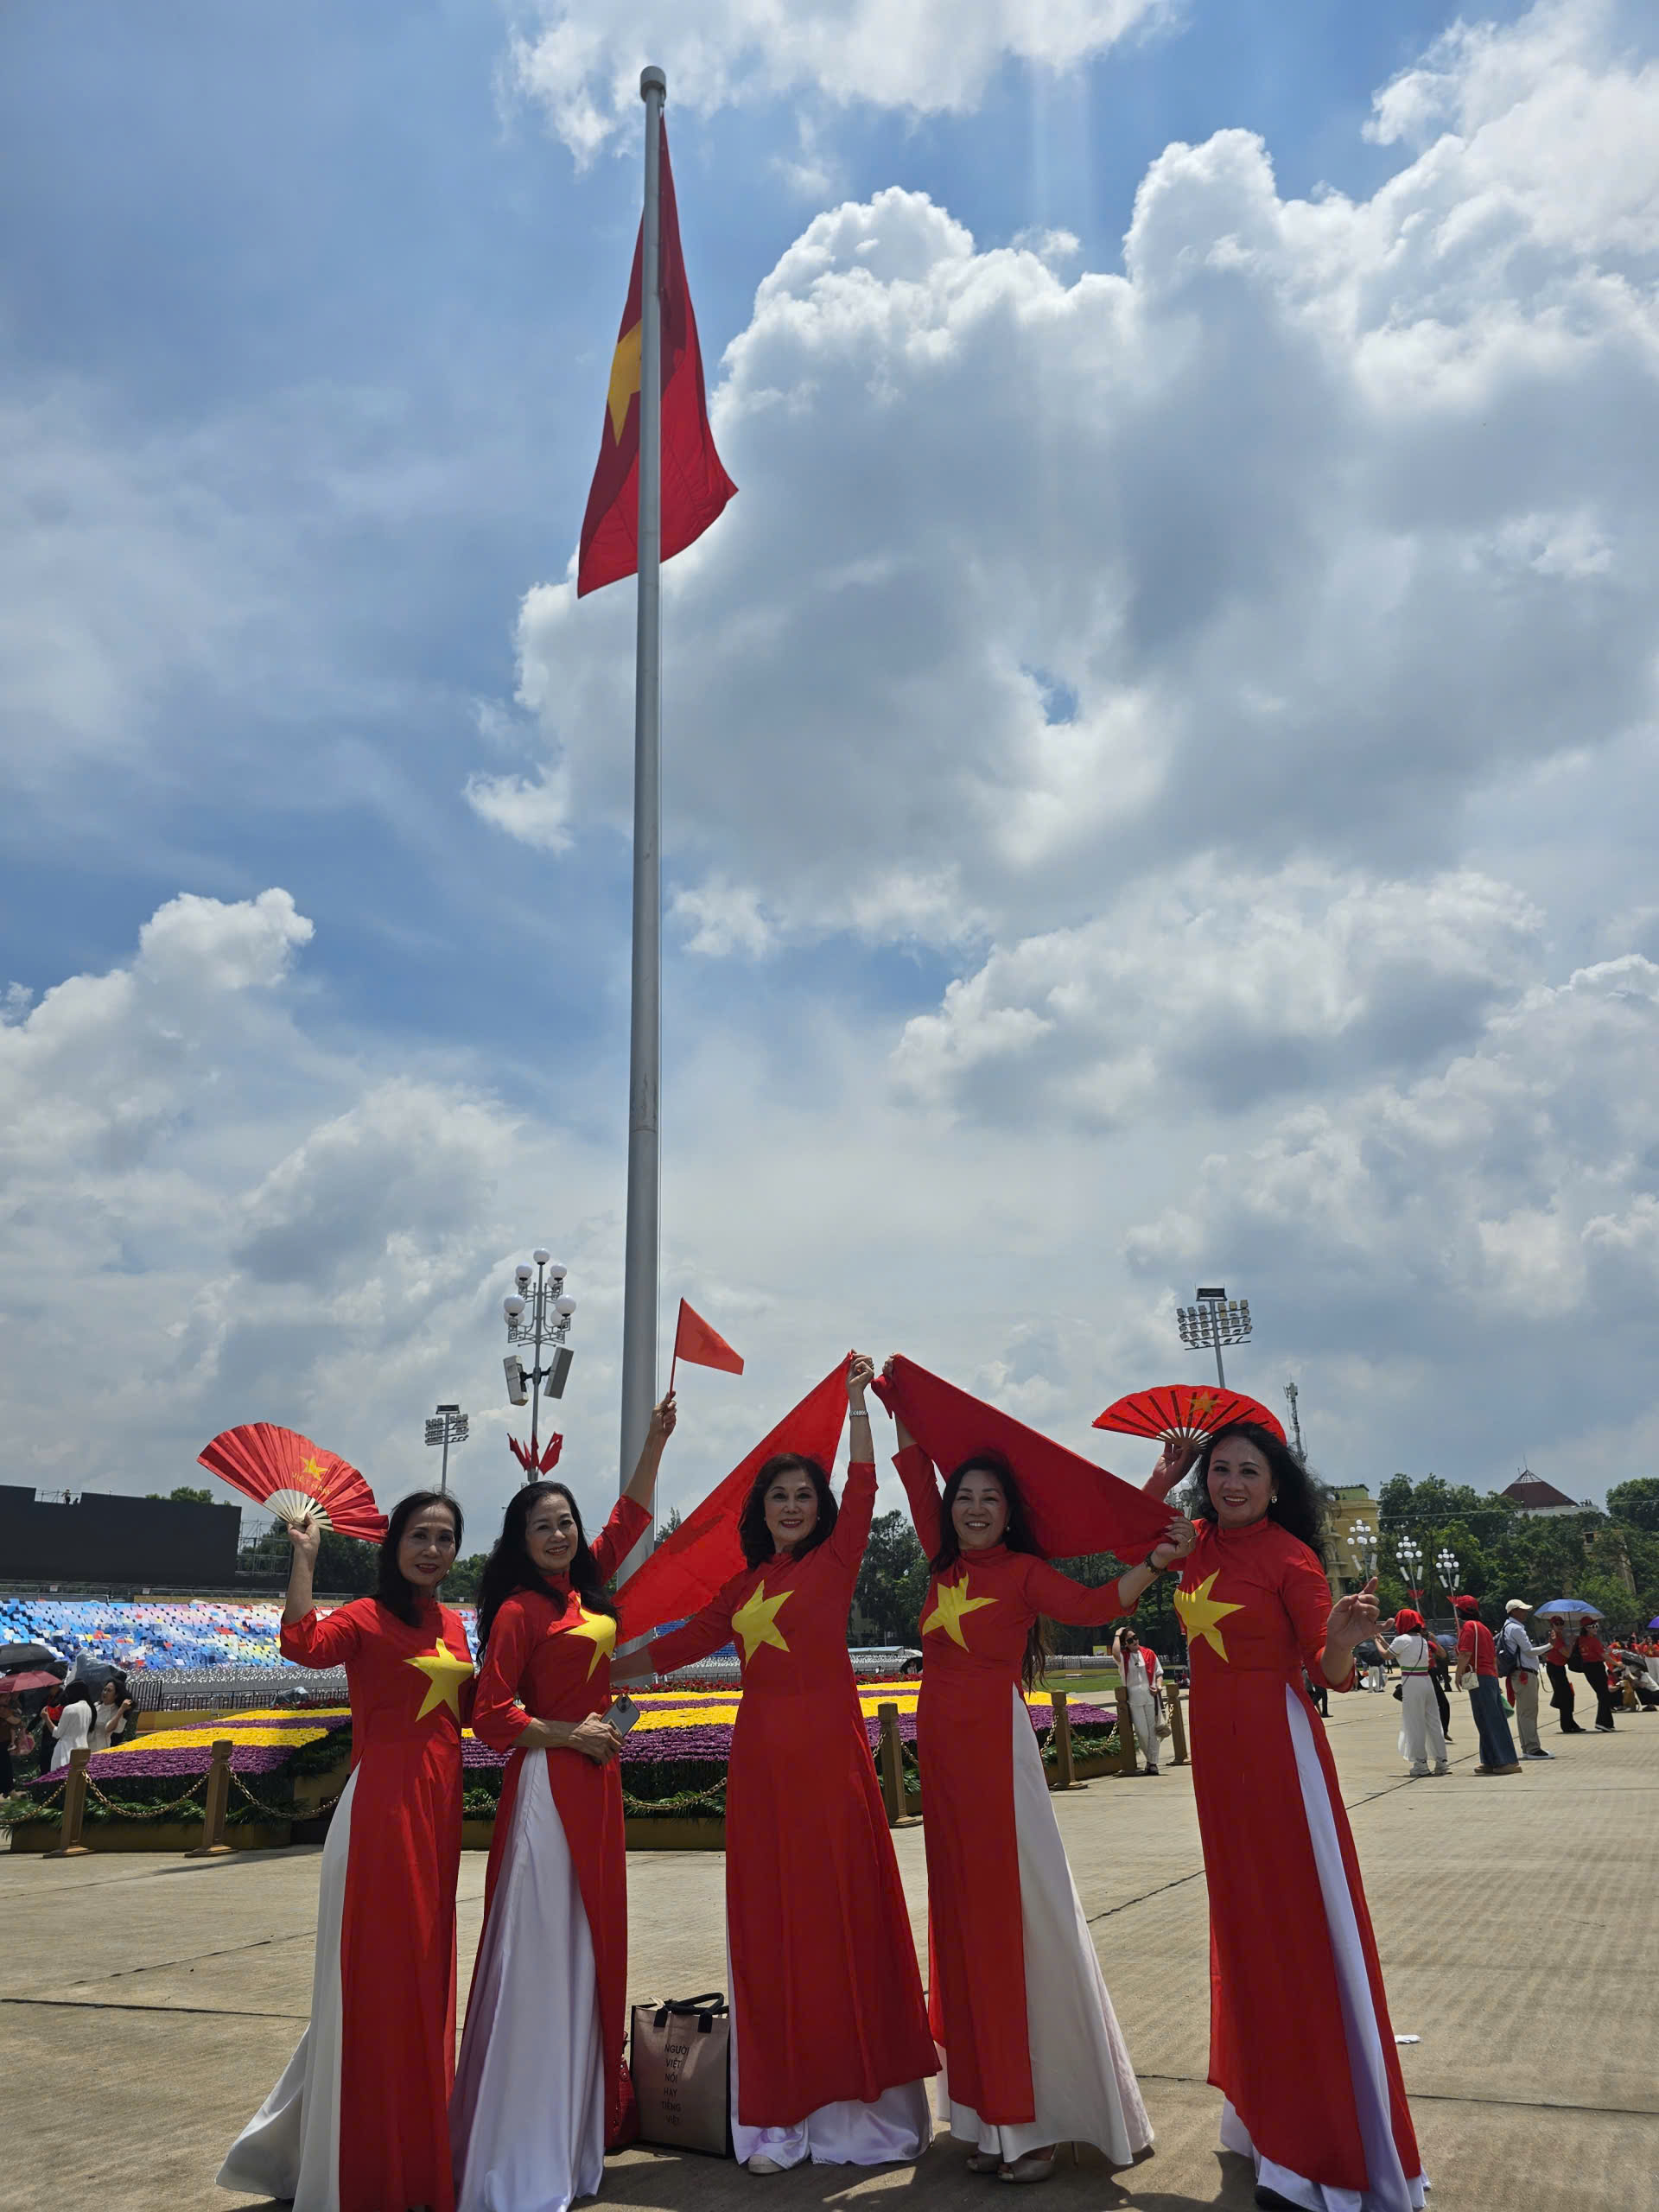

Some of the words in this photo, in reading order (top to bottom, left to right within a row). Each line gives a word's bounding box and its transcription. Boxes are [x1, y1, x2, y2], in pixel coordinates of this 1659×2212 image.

[665, 2057, 682, 2069] VIỆT
[664, 2071, 678, 2083] NÓI
[664, 2087, 678, 2097] HAY
